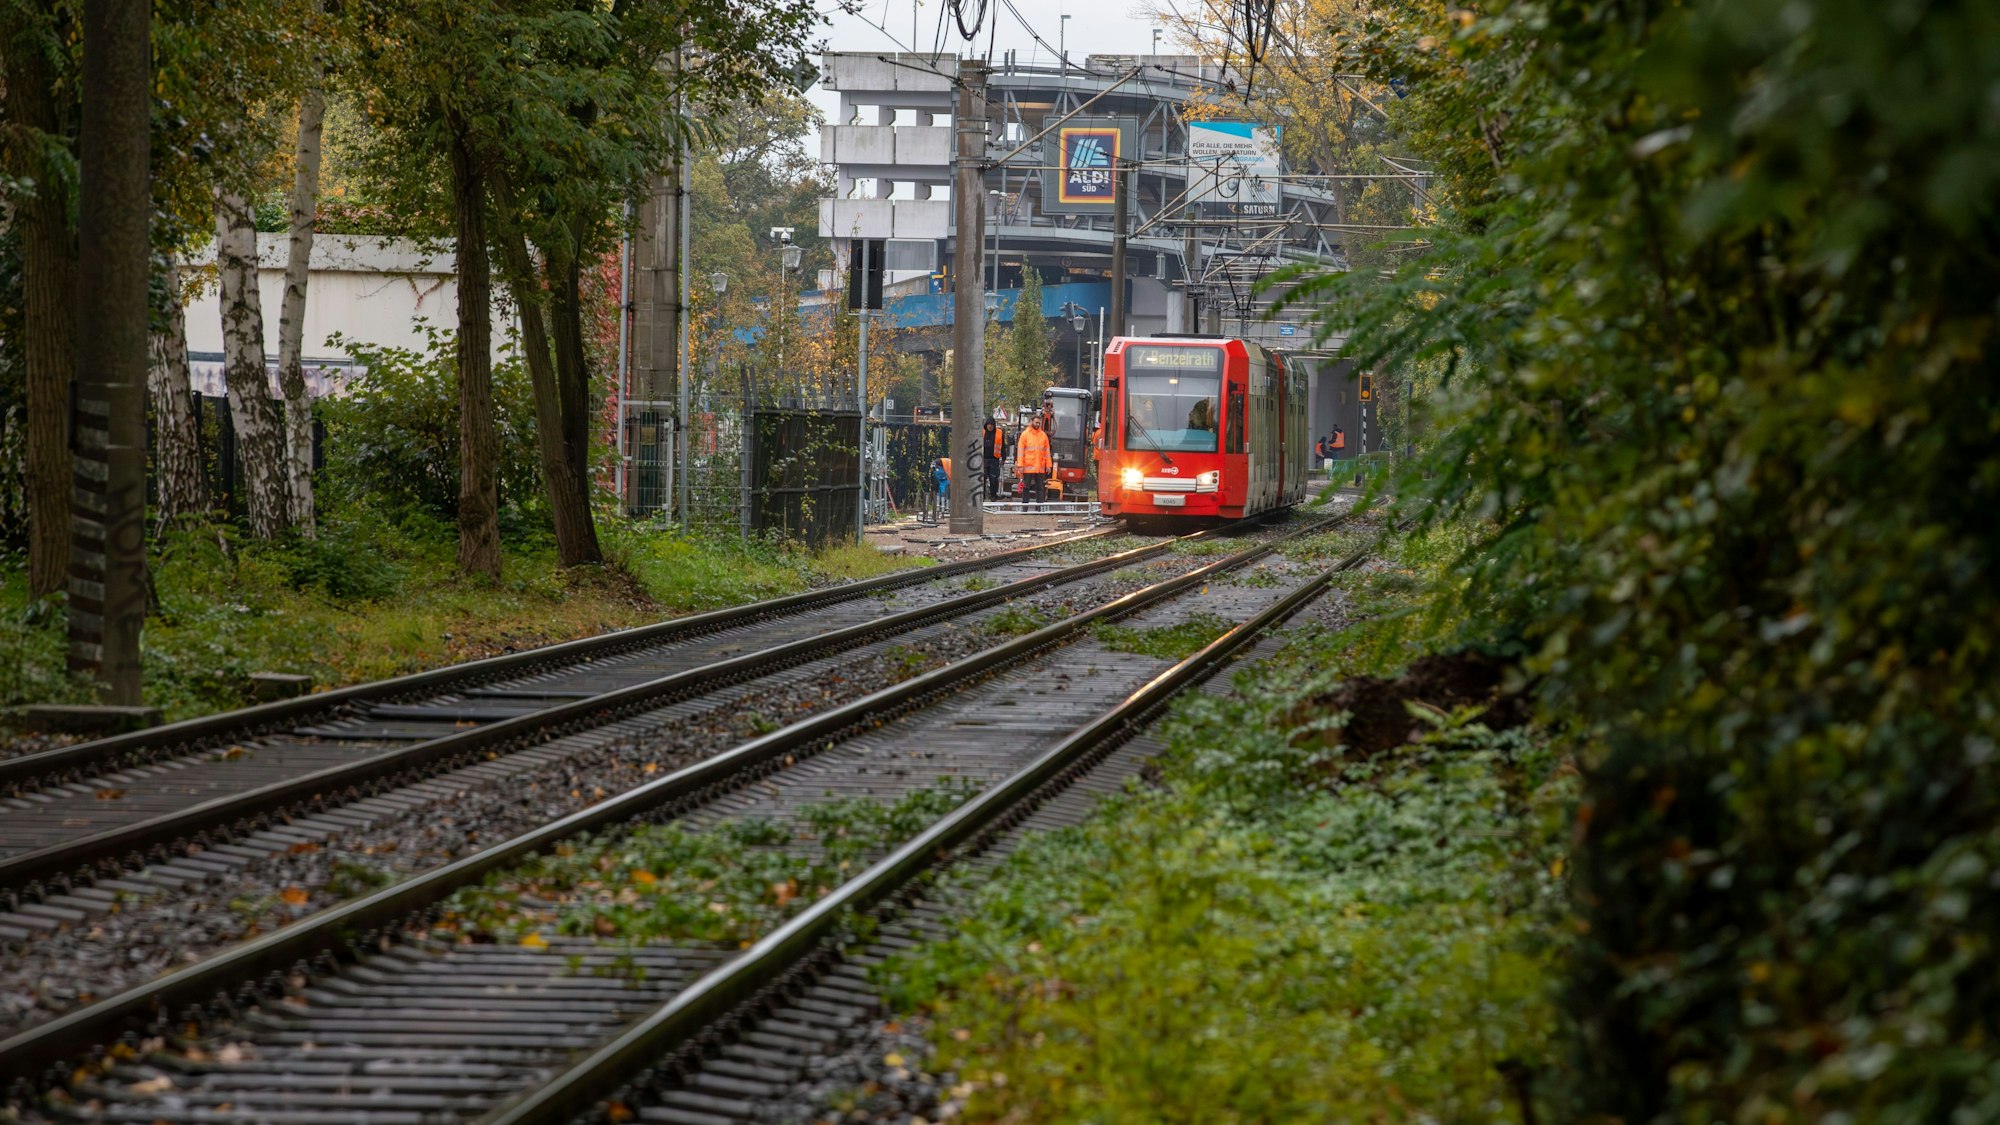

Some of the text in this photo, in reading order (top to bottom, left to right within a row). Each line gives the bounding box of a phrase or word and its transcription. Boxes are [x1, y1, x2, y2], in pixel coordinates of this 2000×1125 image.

[1070, 170, 1109, 184] ALDI
[1082, 184, 1096, 192] SÜD
[1244, 204, 1276, 214] SATURN
[1138, 350, 1214, 366] 7 Benzelrath
[888, 400, 892, 408] 3
